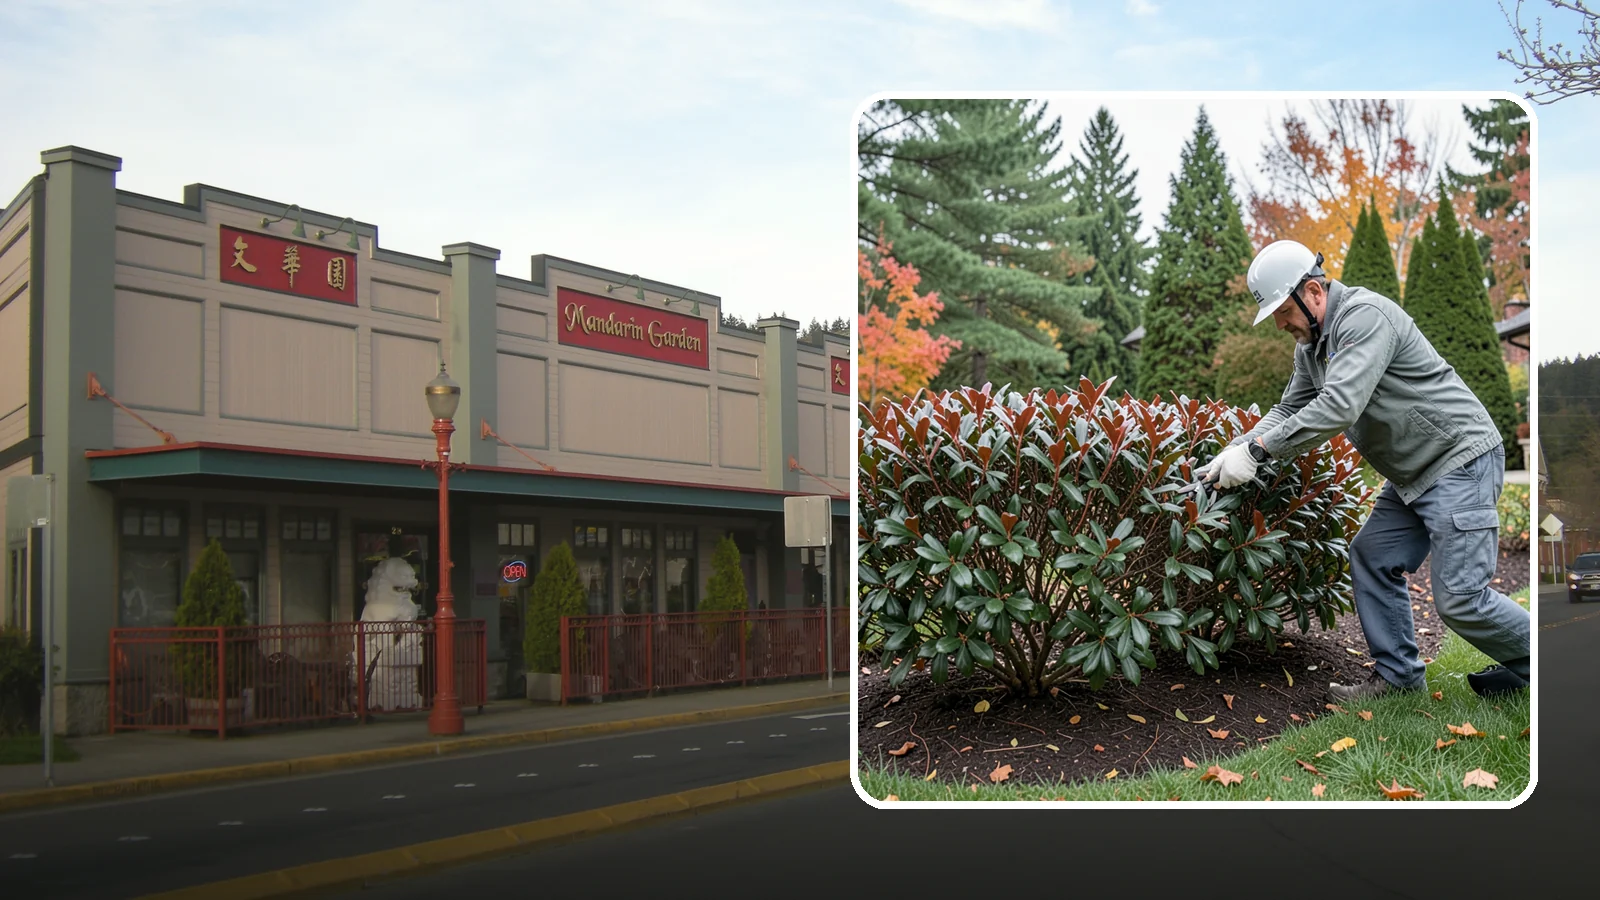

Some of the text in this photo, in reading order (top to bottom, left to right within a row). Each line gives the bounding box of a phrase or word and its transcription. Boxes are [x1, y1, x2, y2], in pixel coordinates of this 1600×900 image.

[564, 302, 702, 353] Mandarin Garden
[503, 565, 526, 578] OPEN
